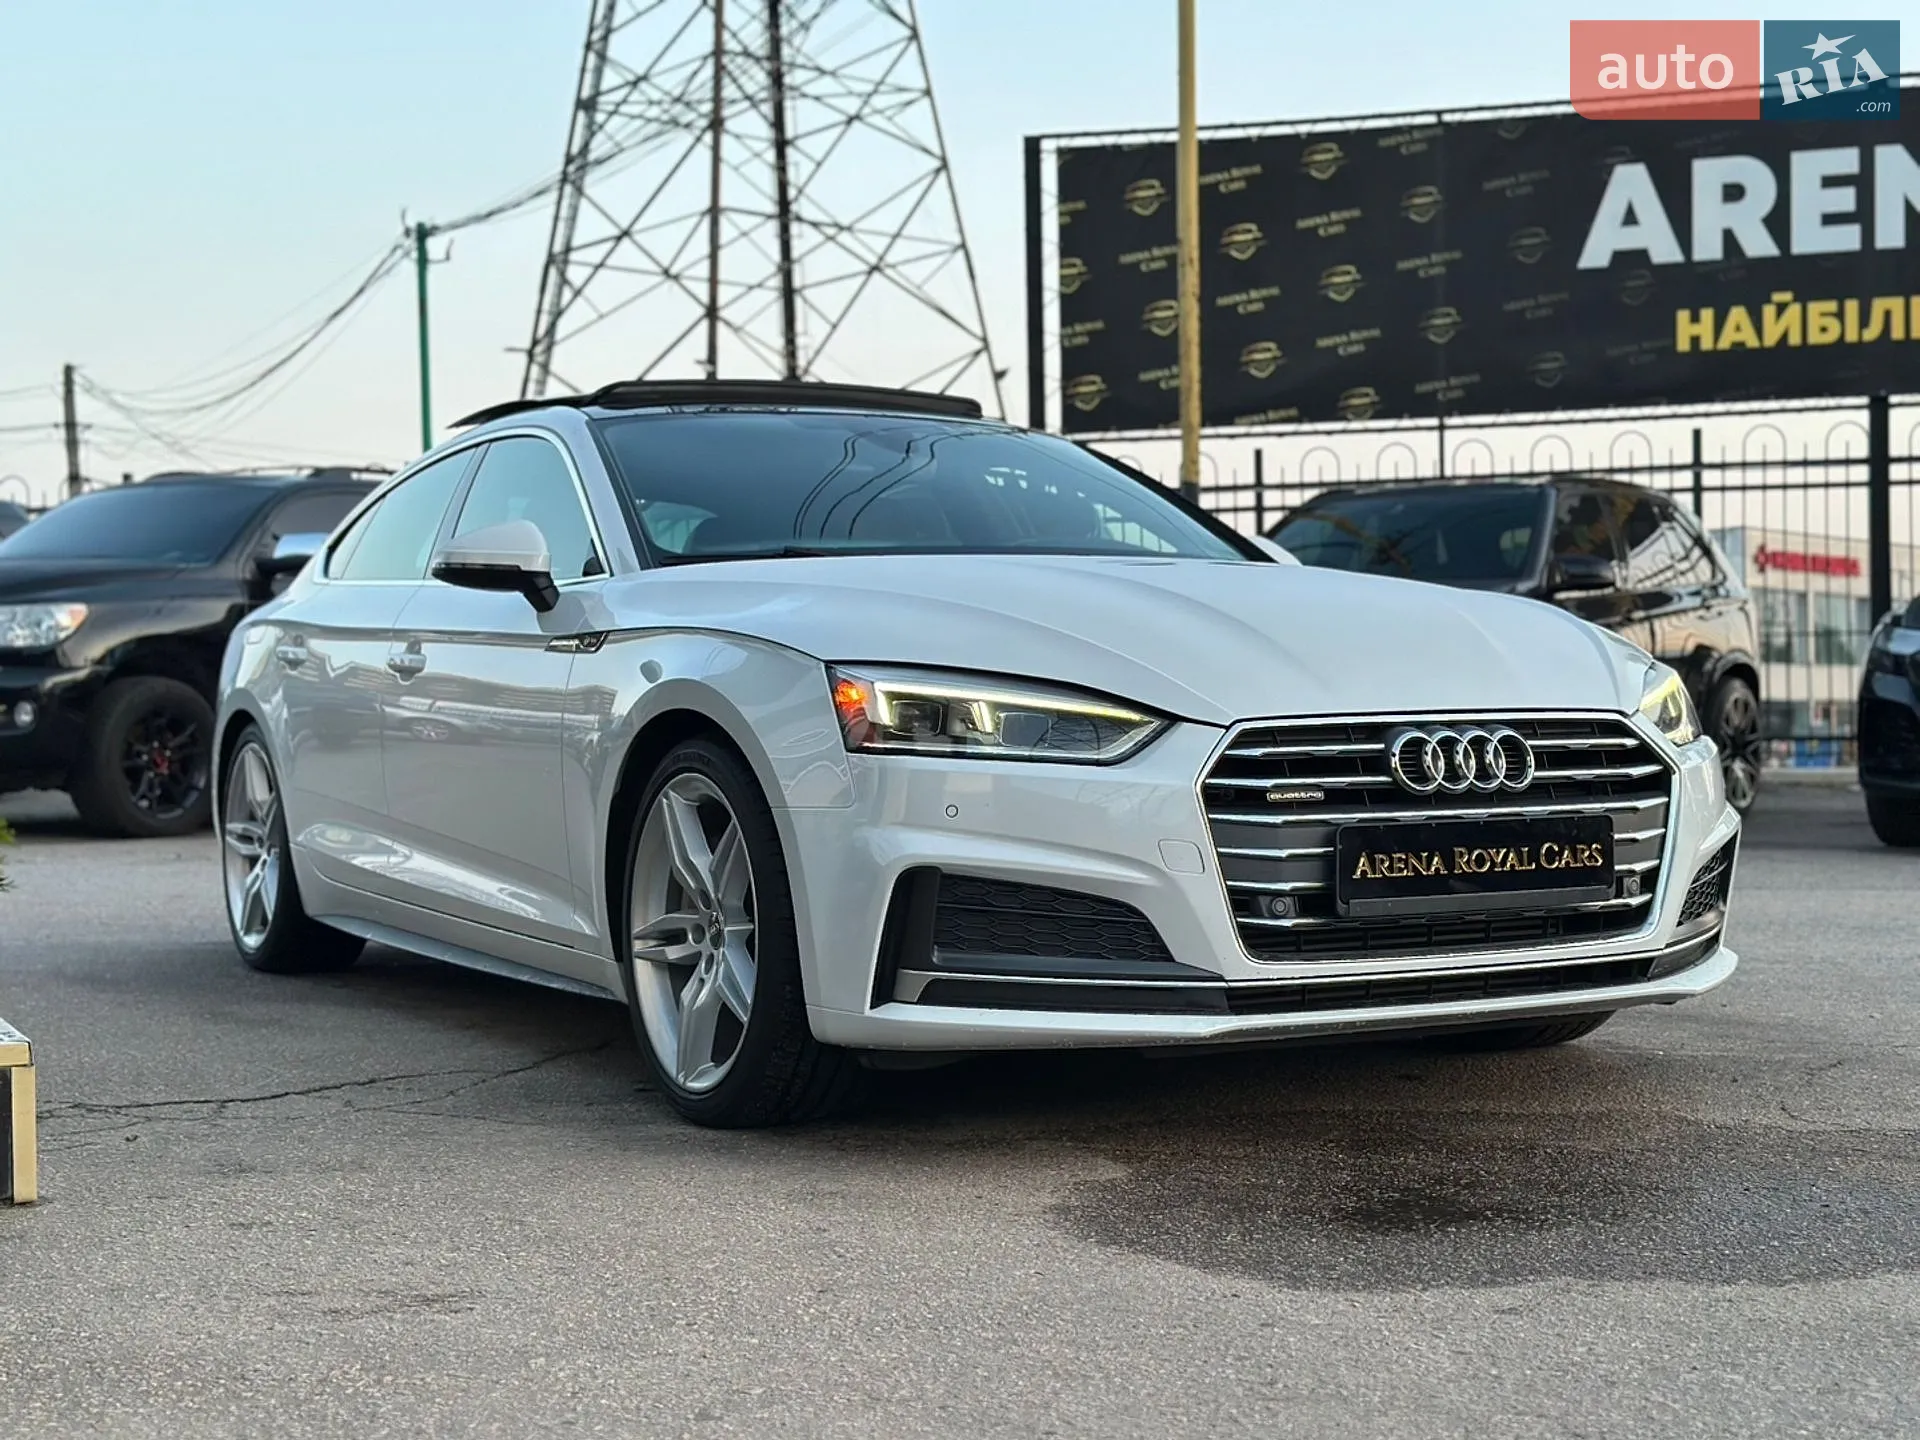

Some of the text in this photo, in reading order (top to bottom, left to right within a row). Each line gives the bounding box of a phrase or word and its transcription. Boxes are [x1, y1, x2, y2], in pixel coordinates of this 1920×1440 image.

[1352, 842, 1604, 879] ARENA ROYAL CARS
